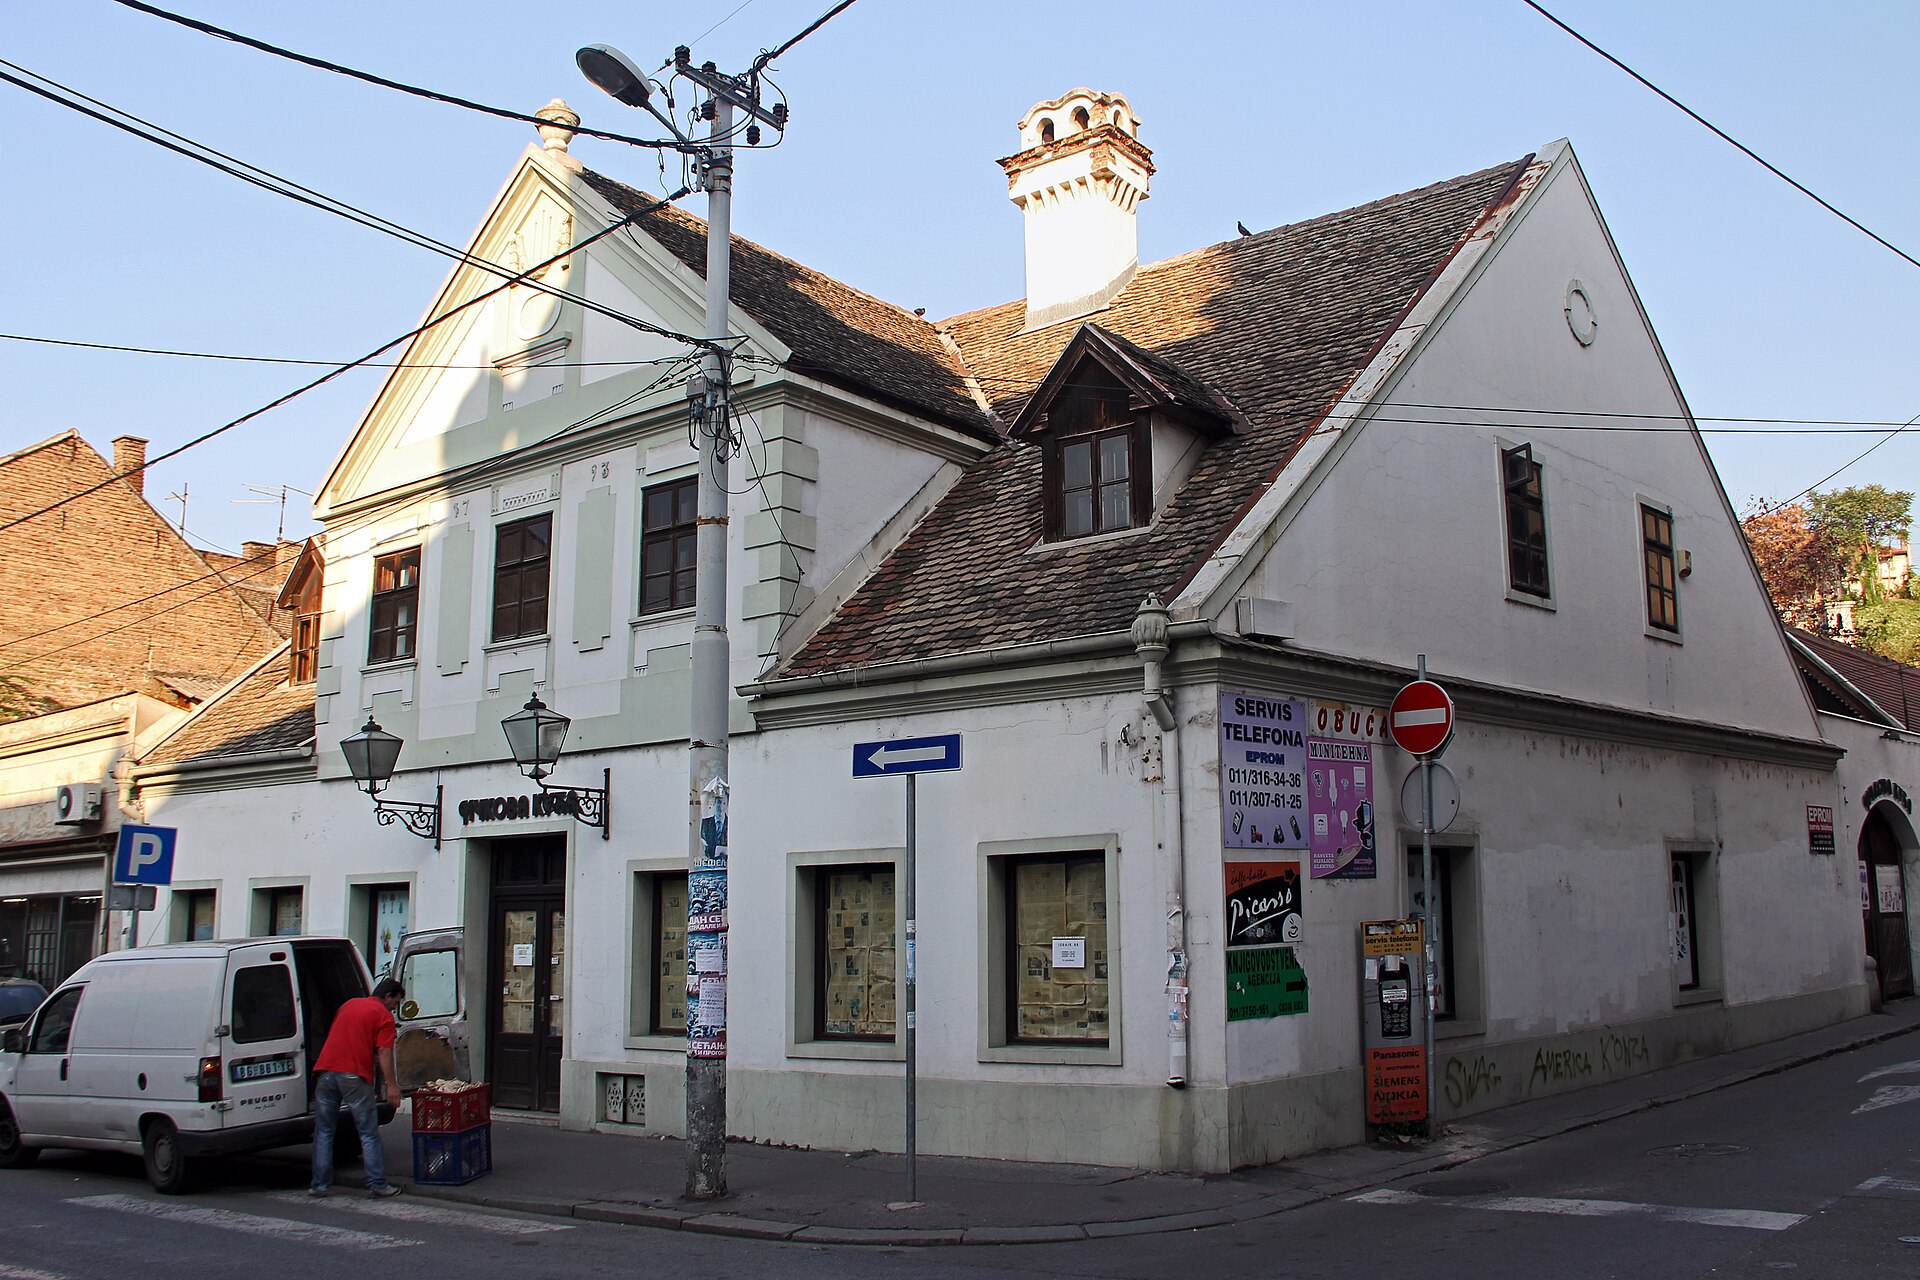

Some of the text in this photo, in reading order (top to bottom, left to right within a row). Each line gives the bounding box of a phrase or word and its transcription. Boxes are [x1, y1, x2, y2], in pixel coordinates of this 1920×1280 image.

[1234, 697, 1293, 721] SERVIS
[1317, 707, 1388, 739] OBUĆA
[1222, 721, 1304, 748] TELEFONA
[1245, 750, 1285, 766] EPROM
[1309, 742, 1370, 761] MINITEHNA
[1229, 767, 1301, 788] 011/316-34-36
[1229, 789, 1302, 809] 011/307-61-25
[128, 832, 163, 877] P
[1230, 887, 1293, 942] Picasso
[1365, 934, 1419, 944] servis telefona
[1247, 973, 1281, 986] AGENCIJA
[1373, 1048, 1420, 1060] Panasonic
[1386, 1063, 1420, 1071] MOTOROLA
[1374, 1075, 1420, 1088] SIEMENS
[1444, 1054, 1502, 1108] SWAG
[1527, 1046, 1593, 1098] AMERICA
[240, 1093, 287, 1106] PEUGEOT
[1374, 1090, 1420, 1102] NOKIA
